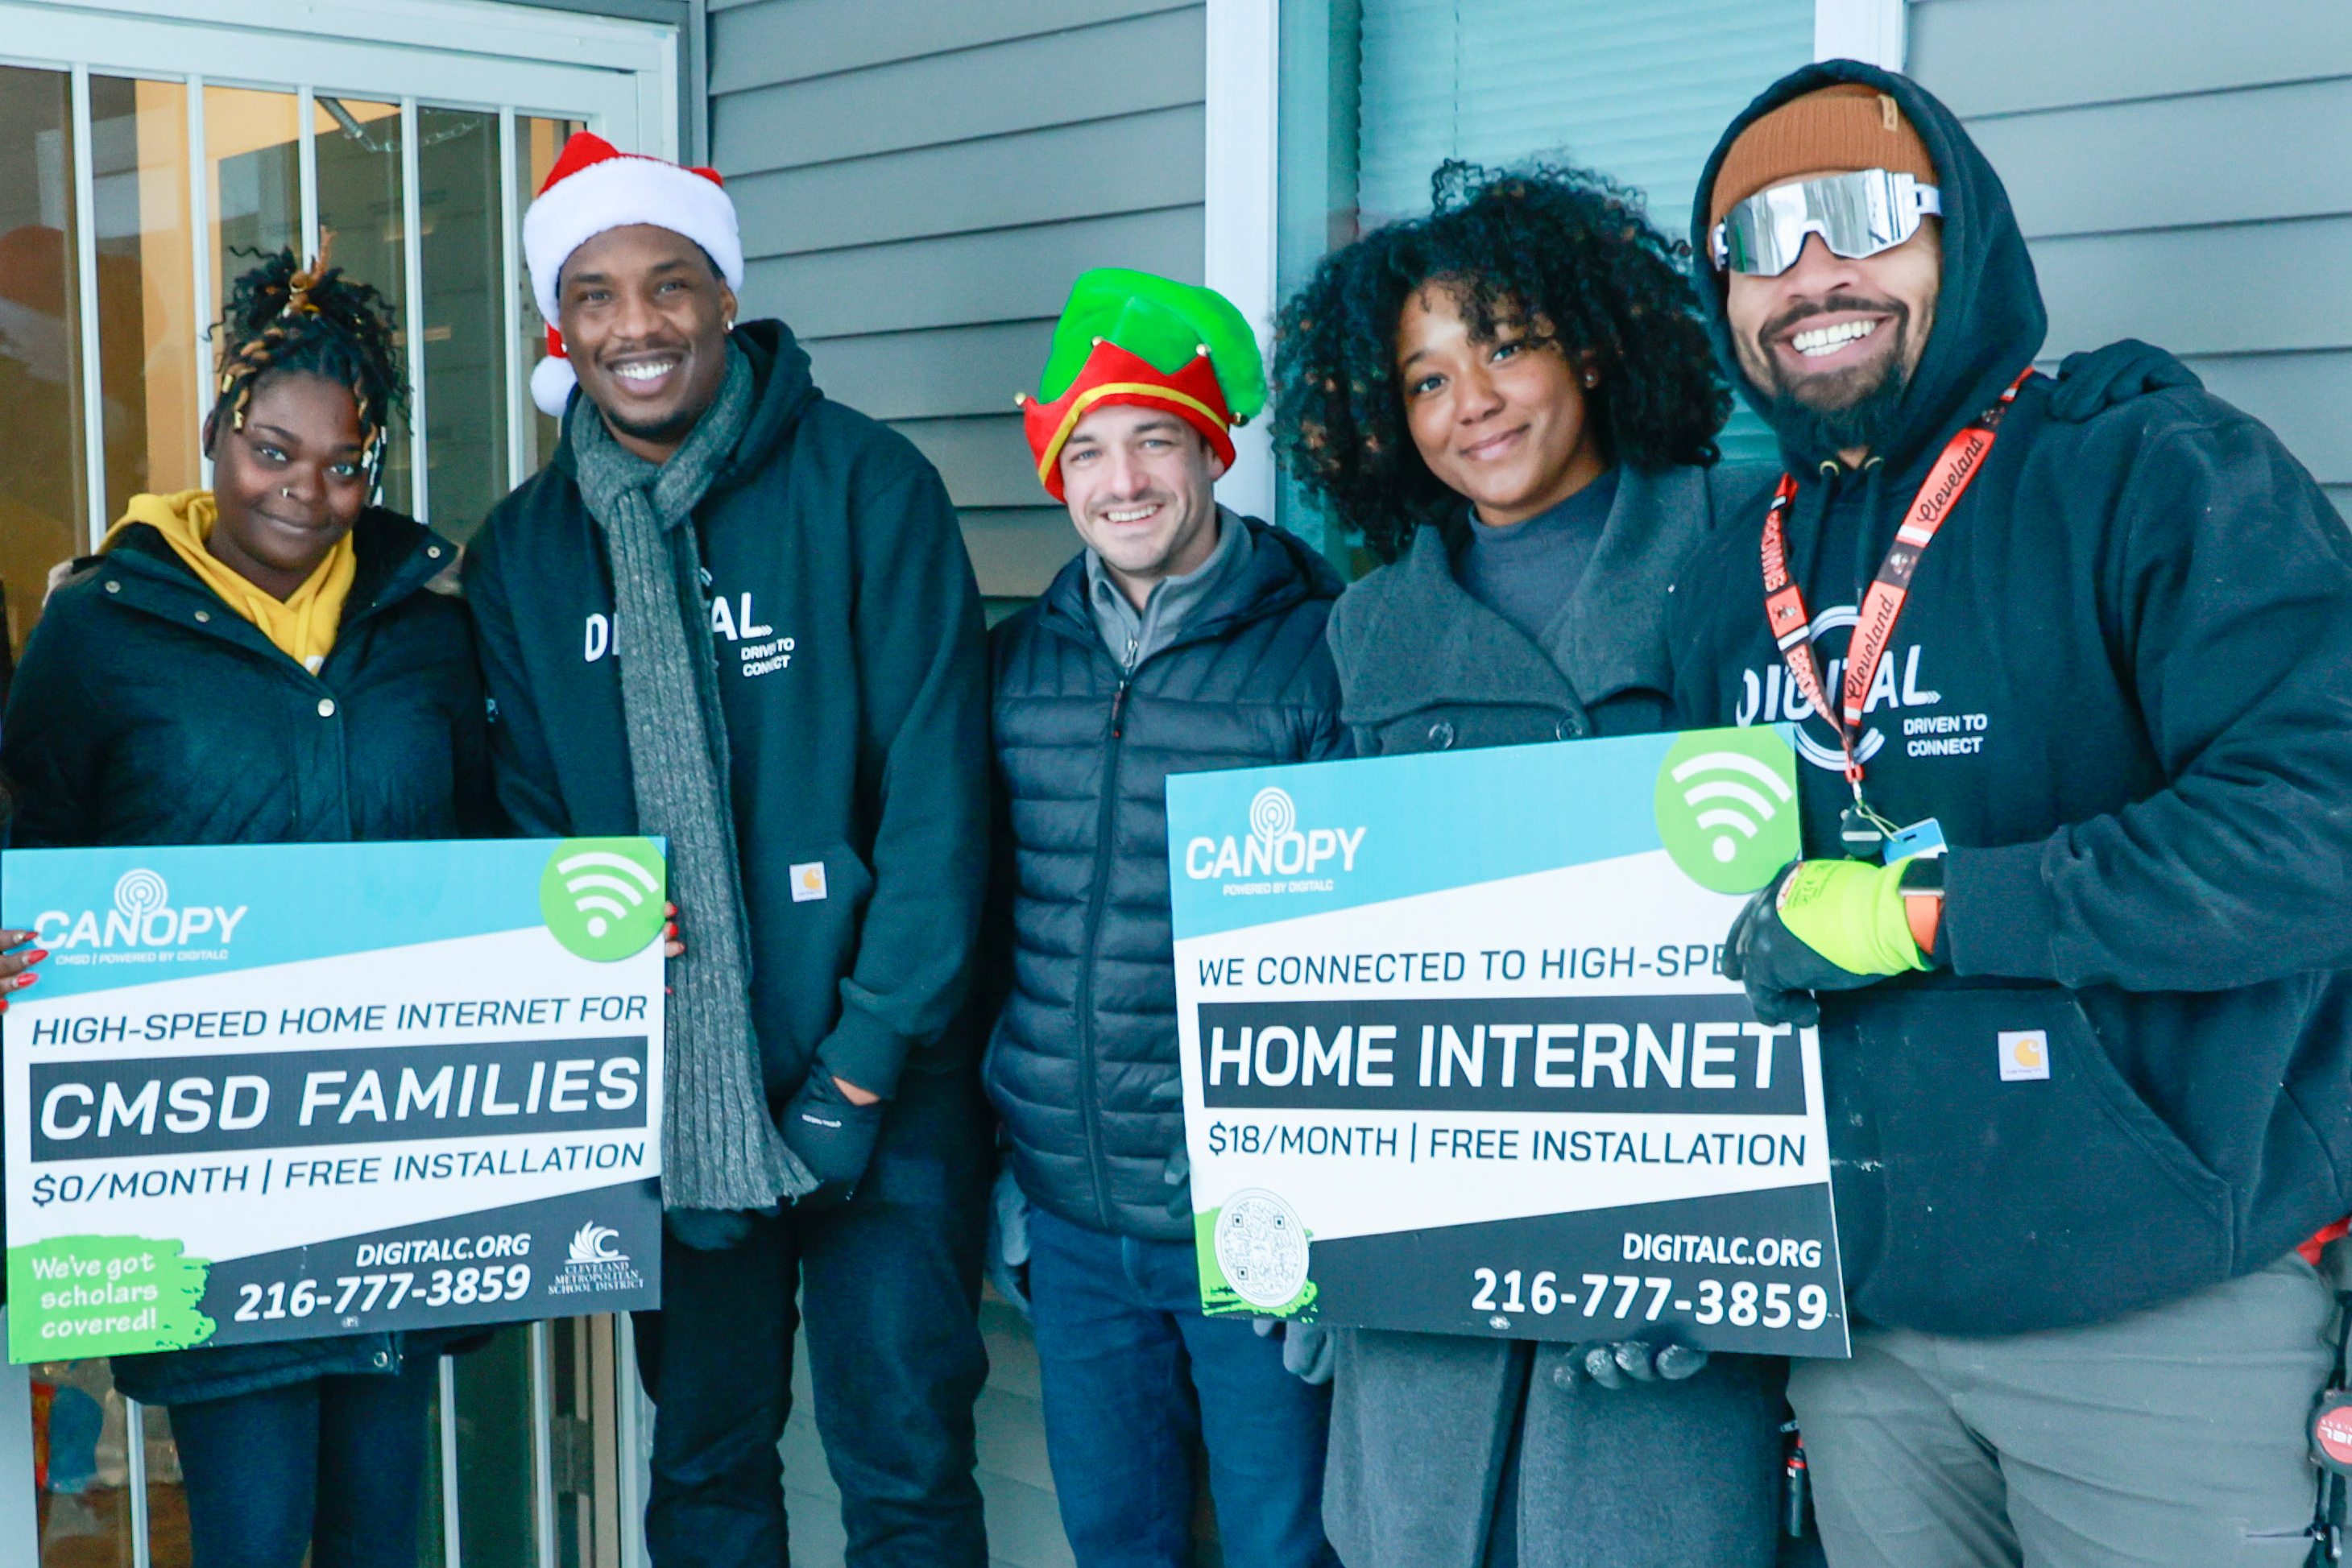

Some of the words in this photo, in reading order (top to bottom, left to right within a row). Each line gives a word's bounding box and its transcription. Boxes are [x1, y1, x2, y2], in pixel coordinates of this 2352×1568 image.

[1916, 435, 1984, 523] Cleveland
[585, 592, 763, 662] DIAL
[776, 637, 795, 652] TO
[1846, 593, 1894, 701] Cleveland
[1903, 716, 1962, 735] DRIVEN
[1963, 714, 1988, 731] TO
[1907, 737, 1983, 757] CONNECT
[1186, 826, 1366, 879] CANOPY
[1224, 883, 1271, 896] POWERED
[1273, 882, 1288, 894] BY
[1289, 879, 1334, 893] DIGITALC
[34, 905, 248, 949] CANOPY
[55, 954, 90, 966] CMSD
[99, 952, 156, 964] POWERED
[159, 952, 176, 962] BY
[177, 949, 229, 962] DIGITALC
[1199, 958, 1244, 987] WE
[1257, 952, 1465, 985] CONNECTED
[1480, 949, 1526, 981] TO
[1541, 944, 1725, 980] HIGH-SPE
[32, 1010, 267, 1046] HIGH-SPEED
[280, 1005, 387, 1035] HOME
[397, 998, 570, 1029] INTERNET
[580, 995, 647, 1022] FOR
[1209, 1025, 1397, 1086] HOME
[1418, 1022, 1792, 1089] INTERNET
[41, 1075, 271, 1140] CMSD
[299, 1057, 640, 1126] FAMILIES
[1208, 1121, 1397, 1157] $18/MONTH
[1430, 1128, 1519, 1160] FREE
[1532, 1130, 1805, 1166] INSTALLATION
[32, 1165, 249, 1207] $0/MONTH
[285, 1157, 381, 1188] FREE
[394, 1142, 645, 1181] INSTALLATION
[32, 1255, 101, 1280] We've
[106, 1252, 155, 1280] got
[355, 1233, 532, 1268] DIGITALC.ORG
[1622, 1232, 1822, 1268] DIGITALC.ORG
[41, 1282, 159, 1309] scholars
[234, 1264, 532, 1322] 216-777-3859
[1472, 1267, 1828, 1330] 216-777-3859
[41, 1308, 158, 1339] covered!
